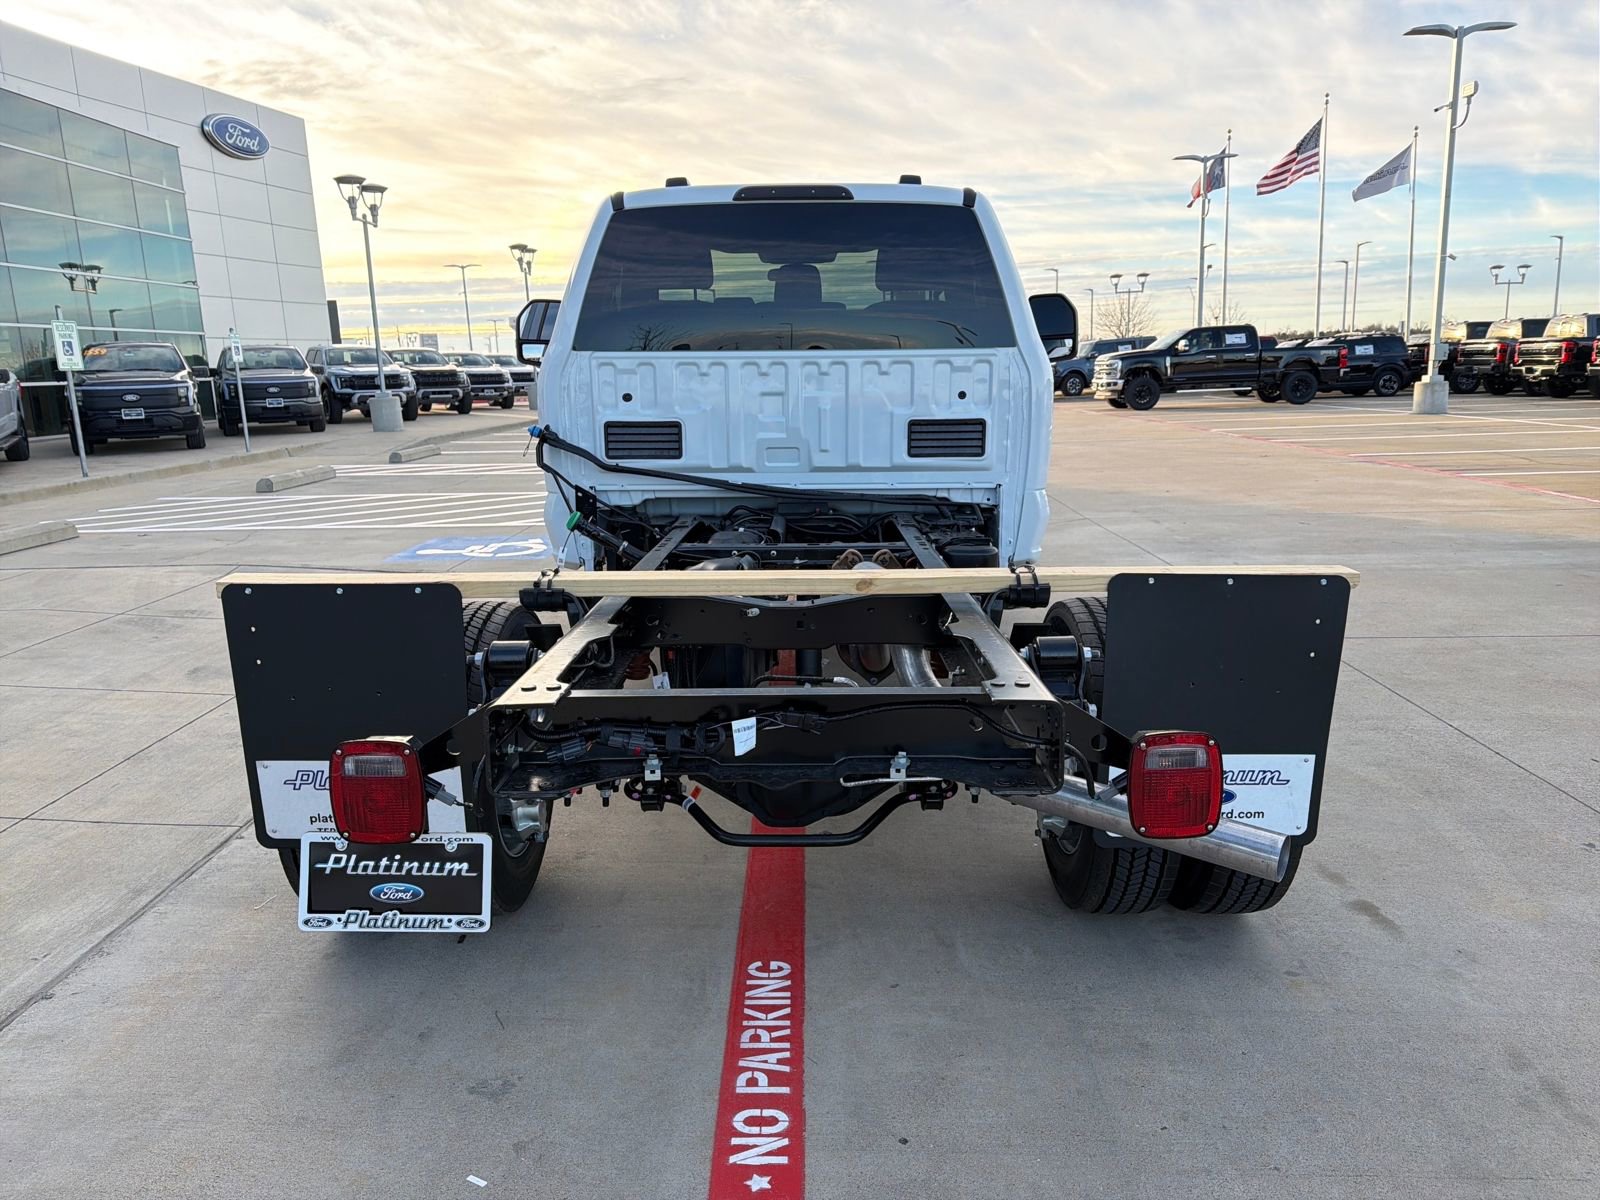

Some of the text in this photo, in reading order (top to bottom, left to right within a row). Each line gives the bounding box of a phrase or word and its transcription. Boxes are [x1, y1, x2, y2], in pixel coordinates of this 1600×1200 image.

[225, 123, 260, 151] Ford
[314, 853, 479, 877] Platinum
[379, 886, 413, 900] Ford
[307, 911, 481, 930] Ford Platinum Ford
[728, 960, 792, 1165] NO PARKING
